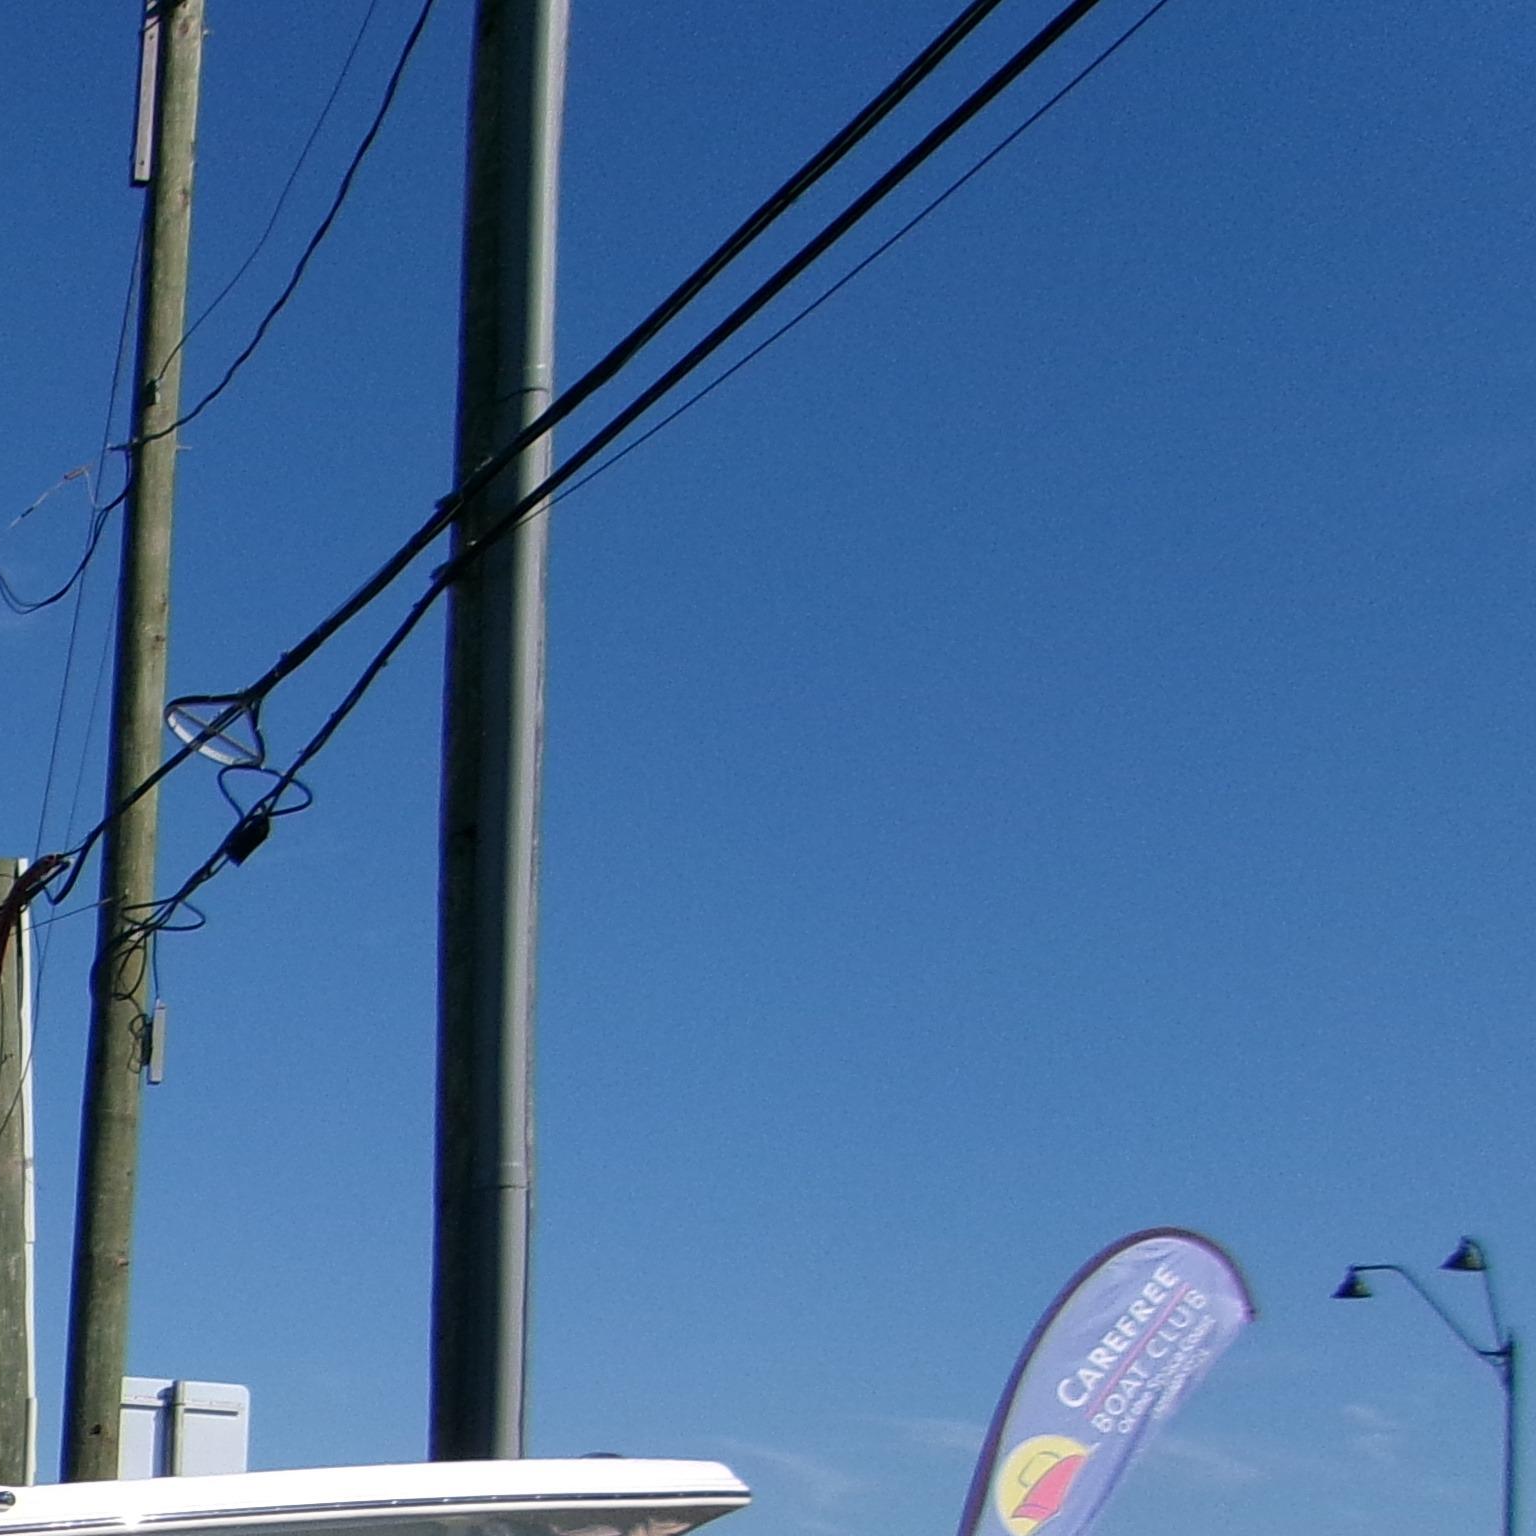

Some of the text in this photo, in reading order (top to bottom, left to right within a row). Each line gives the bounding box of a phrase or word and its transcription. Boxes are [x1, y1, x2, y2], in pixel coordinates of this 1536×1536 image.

[1056, 1262, 1179, 1408] CAREFREE
[1091, 1360, 1150, 1433] BOAT
[1146, 1290, 1207, 1358] CLUB
